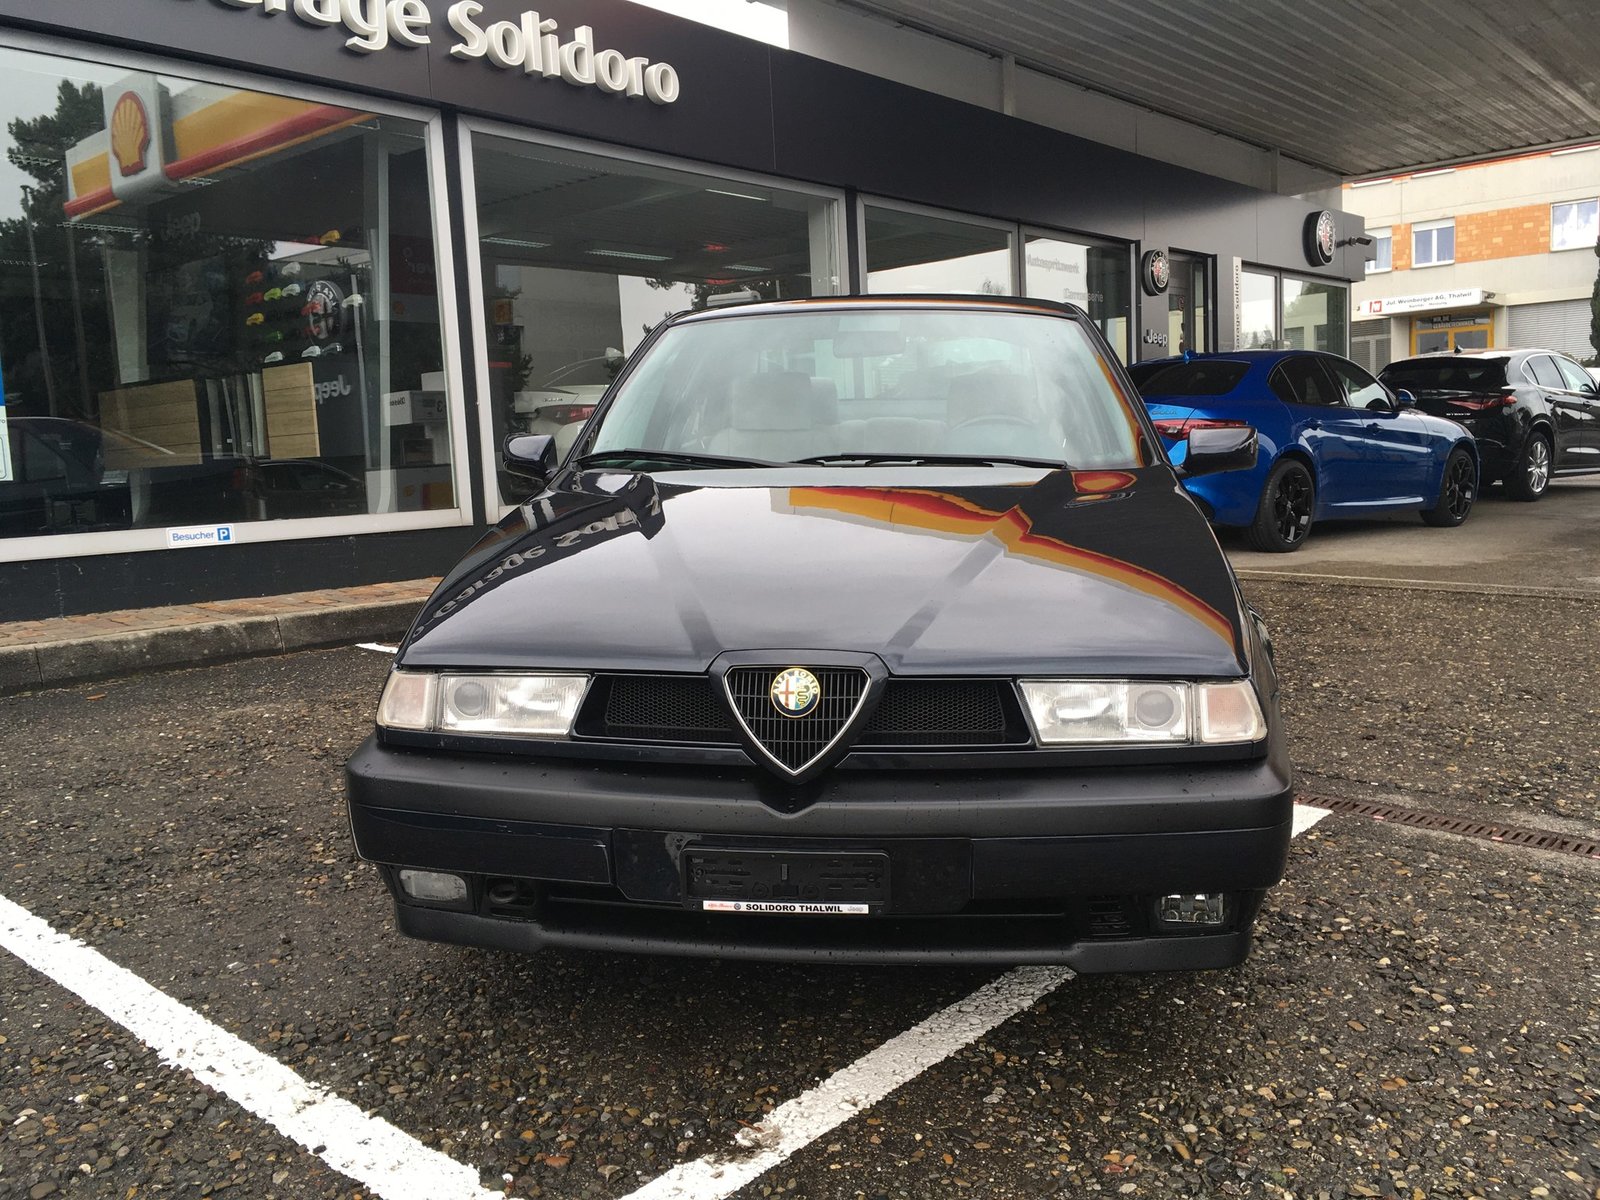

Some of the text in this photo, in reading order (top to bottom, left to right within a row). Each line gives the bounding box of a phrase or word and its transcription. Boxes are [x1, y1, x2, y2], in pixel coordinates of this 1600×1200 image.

[448, 0, 680, 105] Solidoro
[1147, 328, 1168, 348] Jeep
[172, 531, 214, 541] Besucher
[745, 903, 796, 912] SOLIDORO
[799, 904, 843, 913] THALWIL
